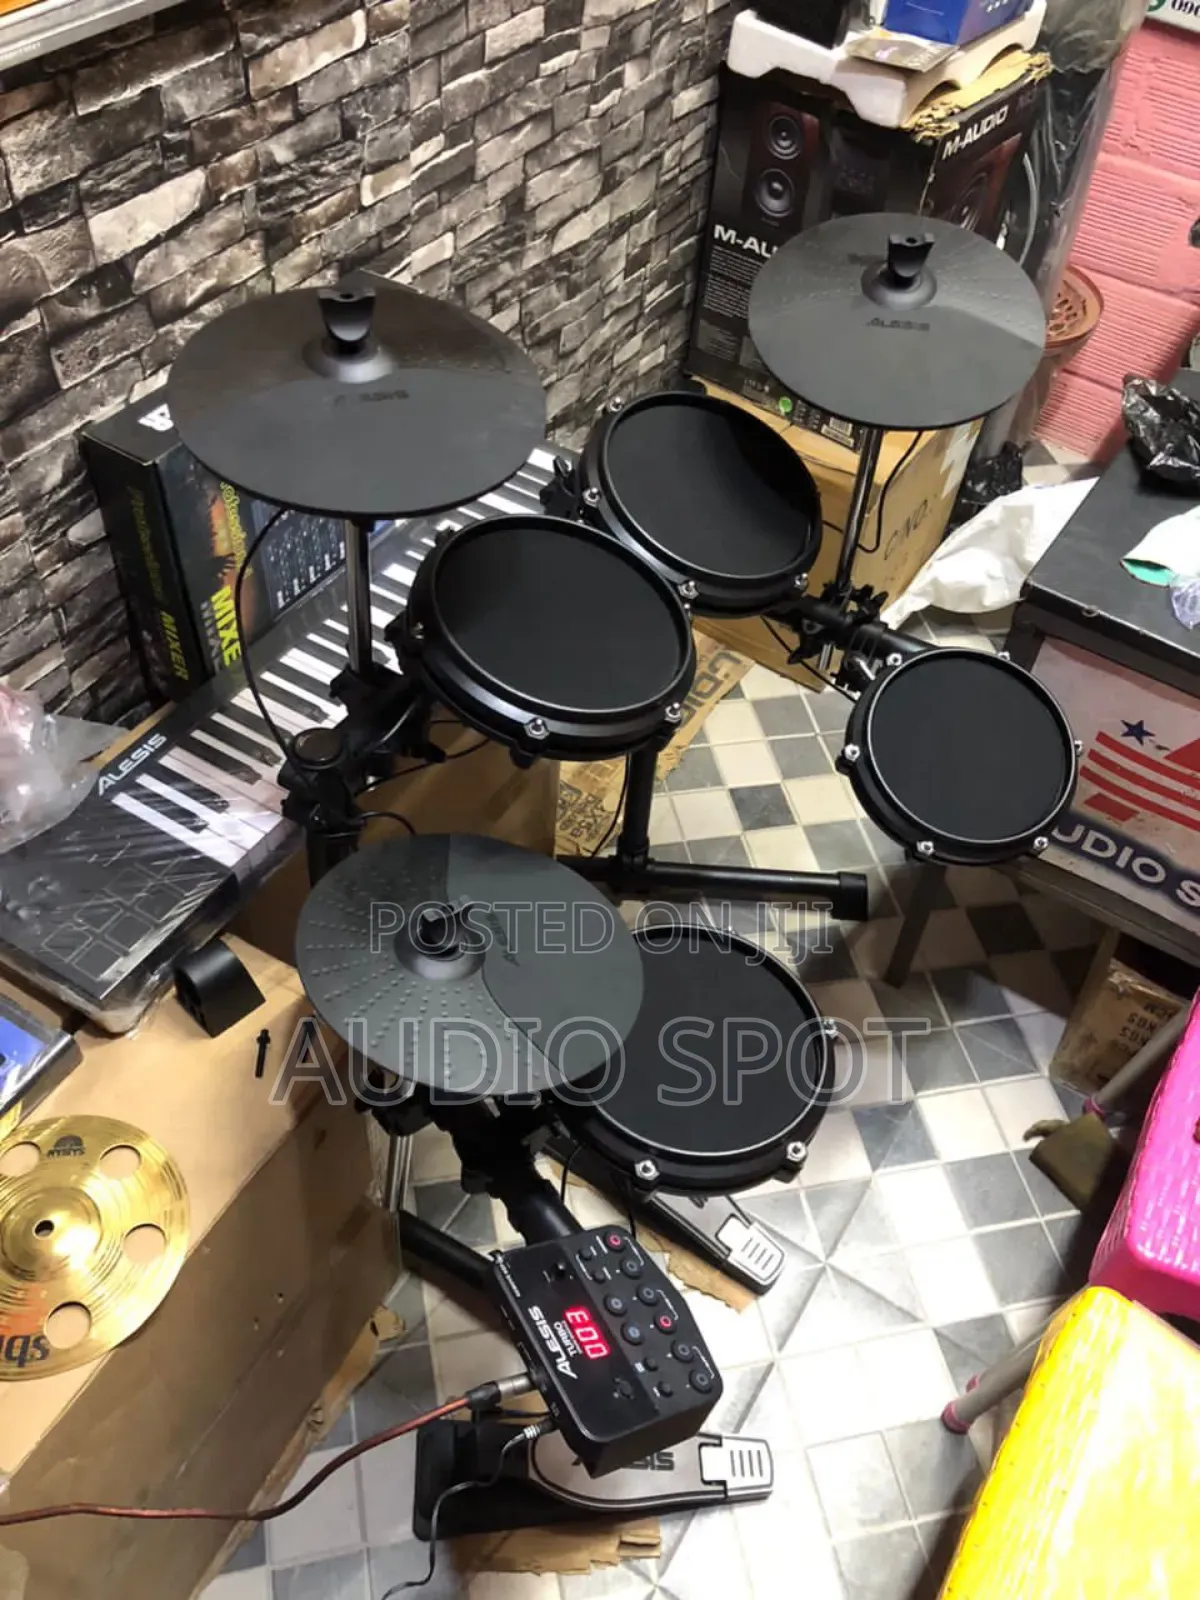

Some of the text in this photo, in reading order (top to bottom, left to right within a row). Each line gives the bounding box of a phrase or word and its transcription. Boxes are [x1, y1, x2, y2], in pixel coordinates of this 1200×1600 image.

[942, 104, 1009, 160] M-AUDIO
[713, 223, 779, 258] M-AU
[160, 610, 189, 682] MIXER
[210, 584, 242, 667] MIXE
[98, 733, 168, 796] ALESIS
[1050, 824, 1167, 883] UDIO
[527, 1304, 579, 1380] ALESIS
[553, 1321, 577, 1358] TURBO
